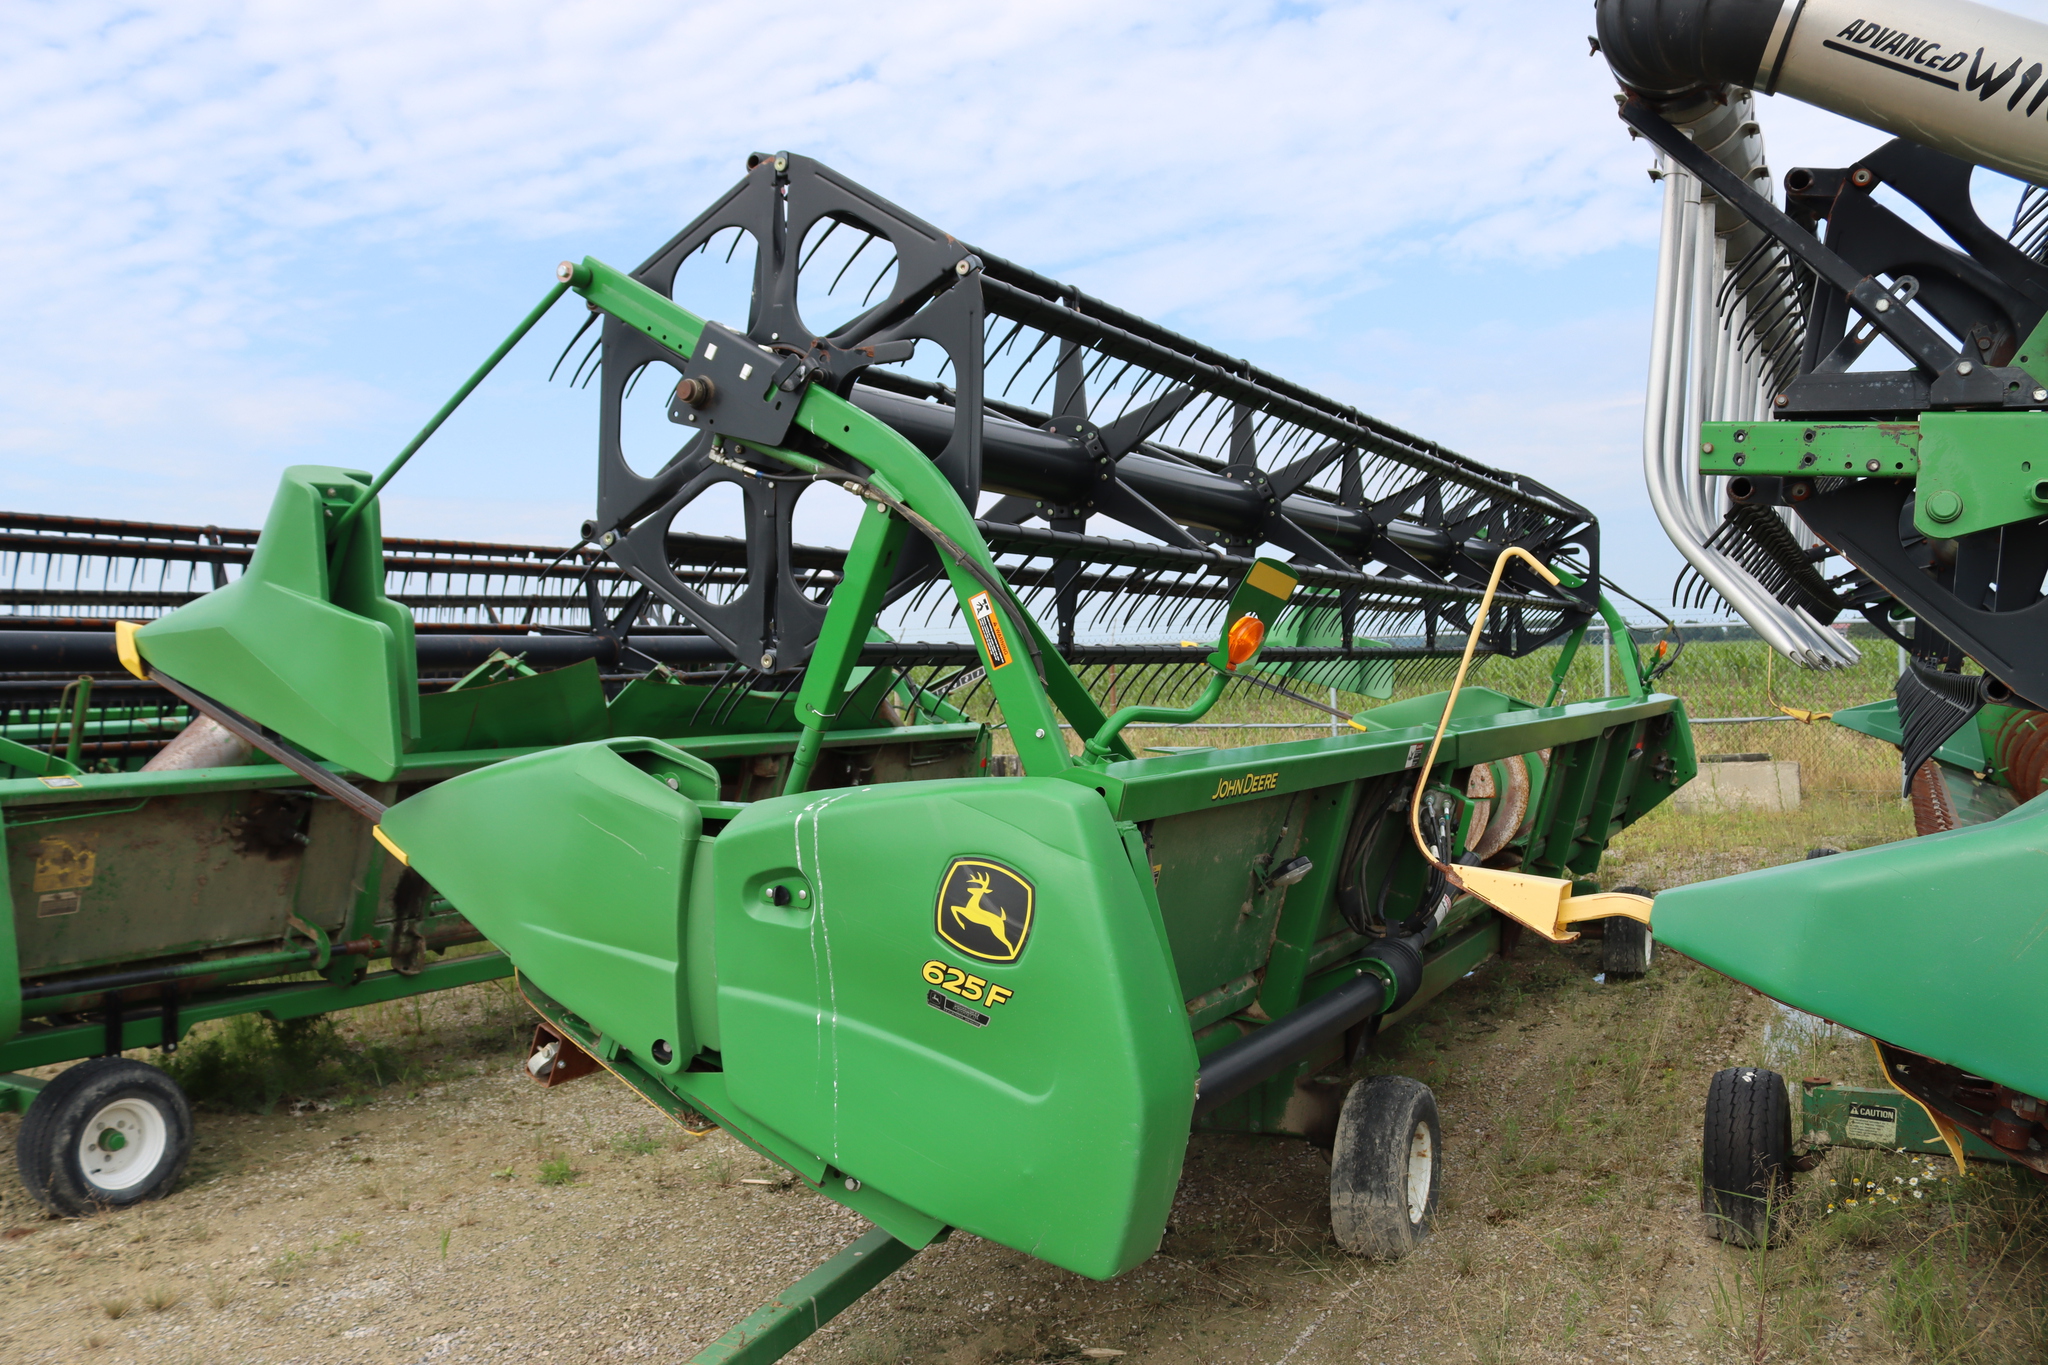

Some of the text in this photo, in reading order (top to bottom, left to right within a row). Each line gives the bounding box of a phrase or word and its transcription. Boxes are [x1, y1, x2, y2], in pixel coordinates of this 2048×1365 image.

[1837, 18, 1969, 73] ADVANCED
[995, 628, 1009, 656] WARNING
[921, 959, 1015, 1009] 625F
[1859, 1108, 1894, 1120] CAUTION
